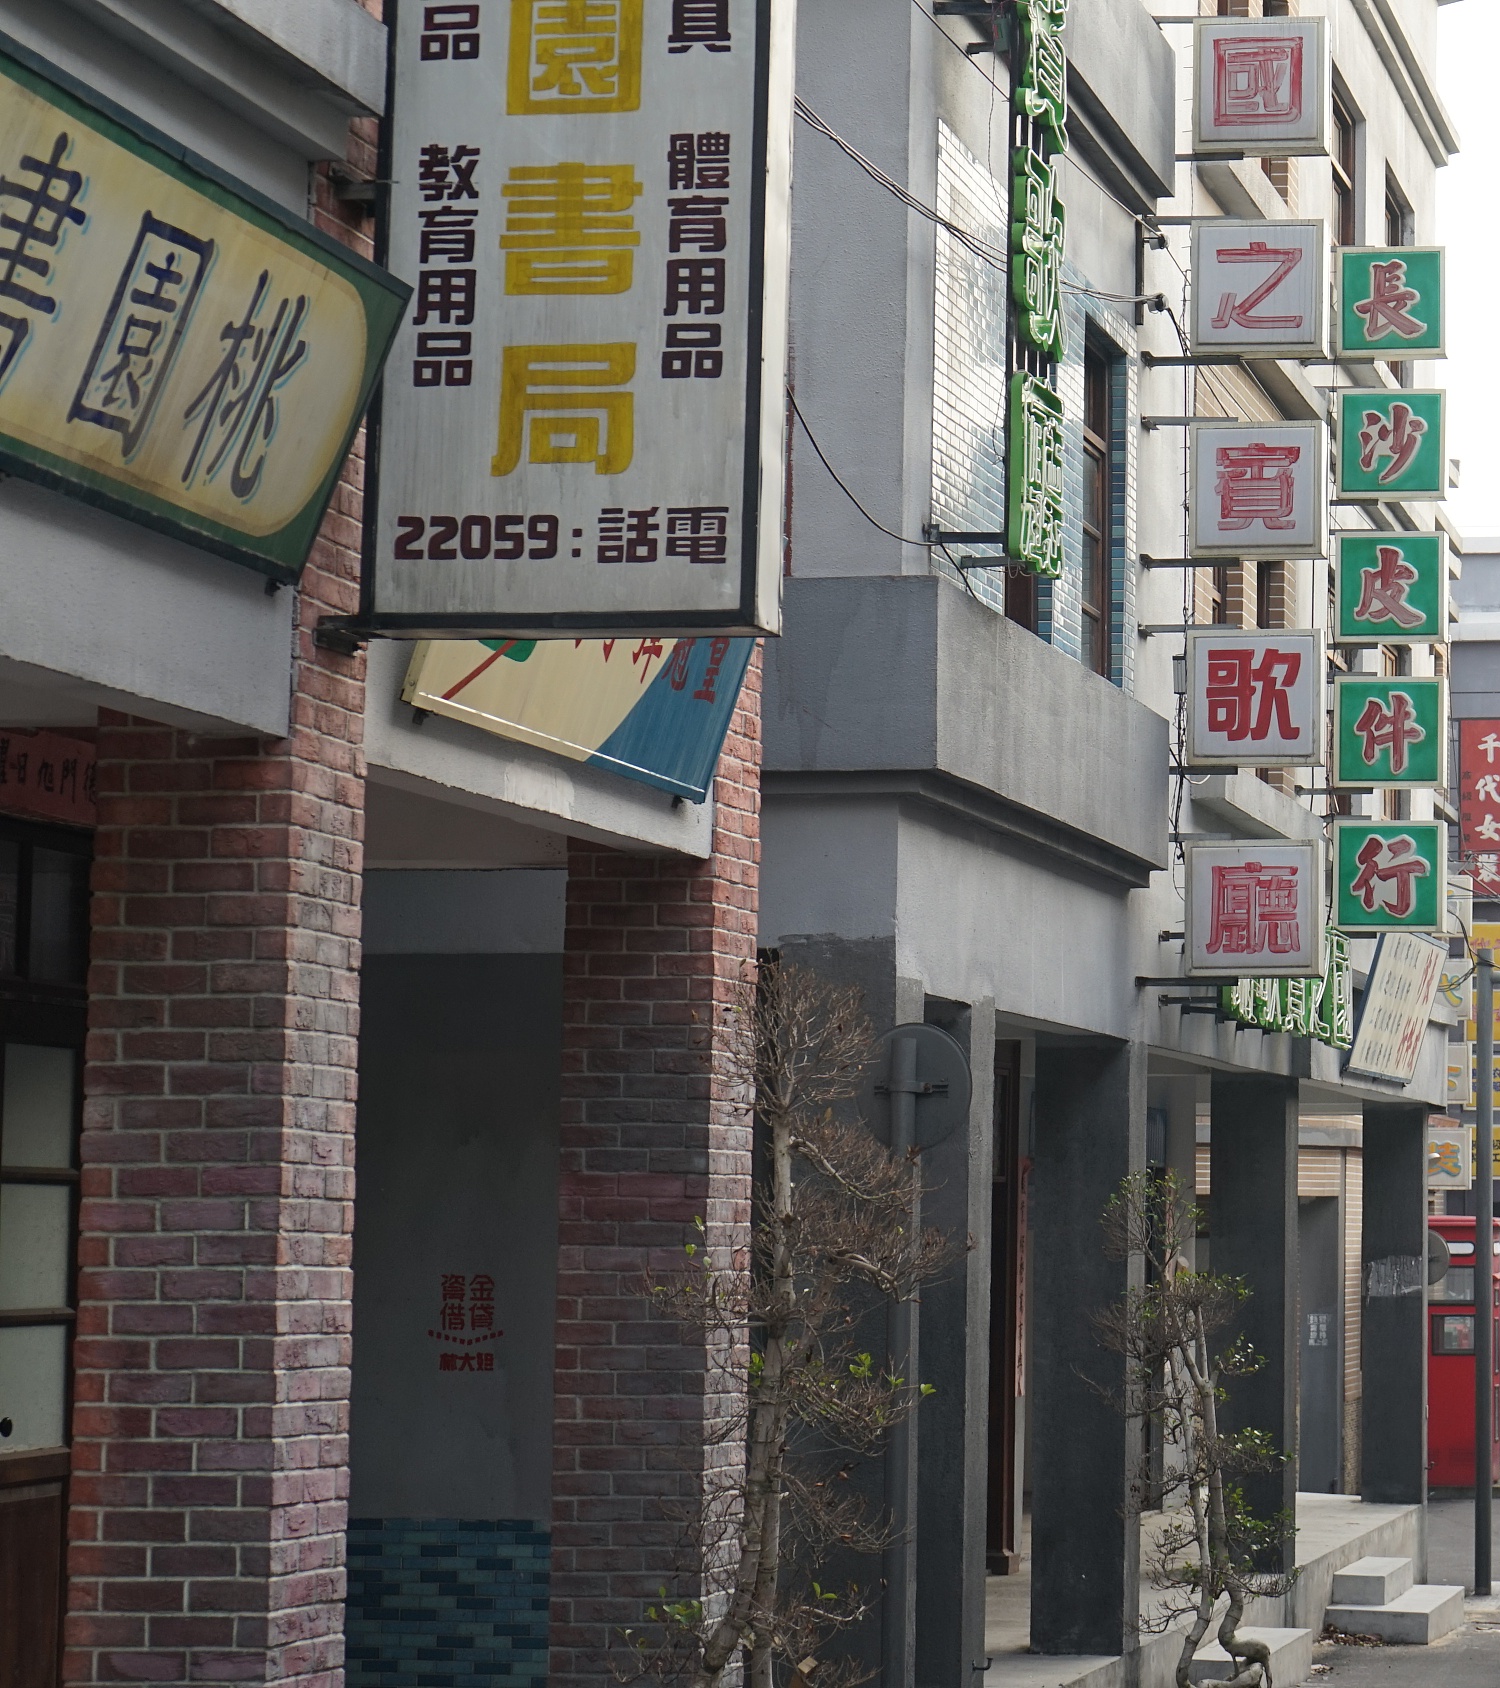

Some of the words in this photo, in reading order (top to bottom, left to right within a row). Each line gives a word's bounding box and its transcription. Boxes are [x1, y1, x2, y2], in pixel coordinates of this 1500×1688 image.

[413, 144, 480, 387] 教育用品
[661, 131, 731, 379] 體育用品
[1206, 37, 1304, 955] 國之賓歌廳
[1352, 260, 1430, 917] 長沙皮件行
